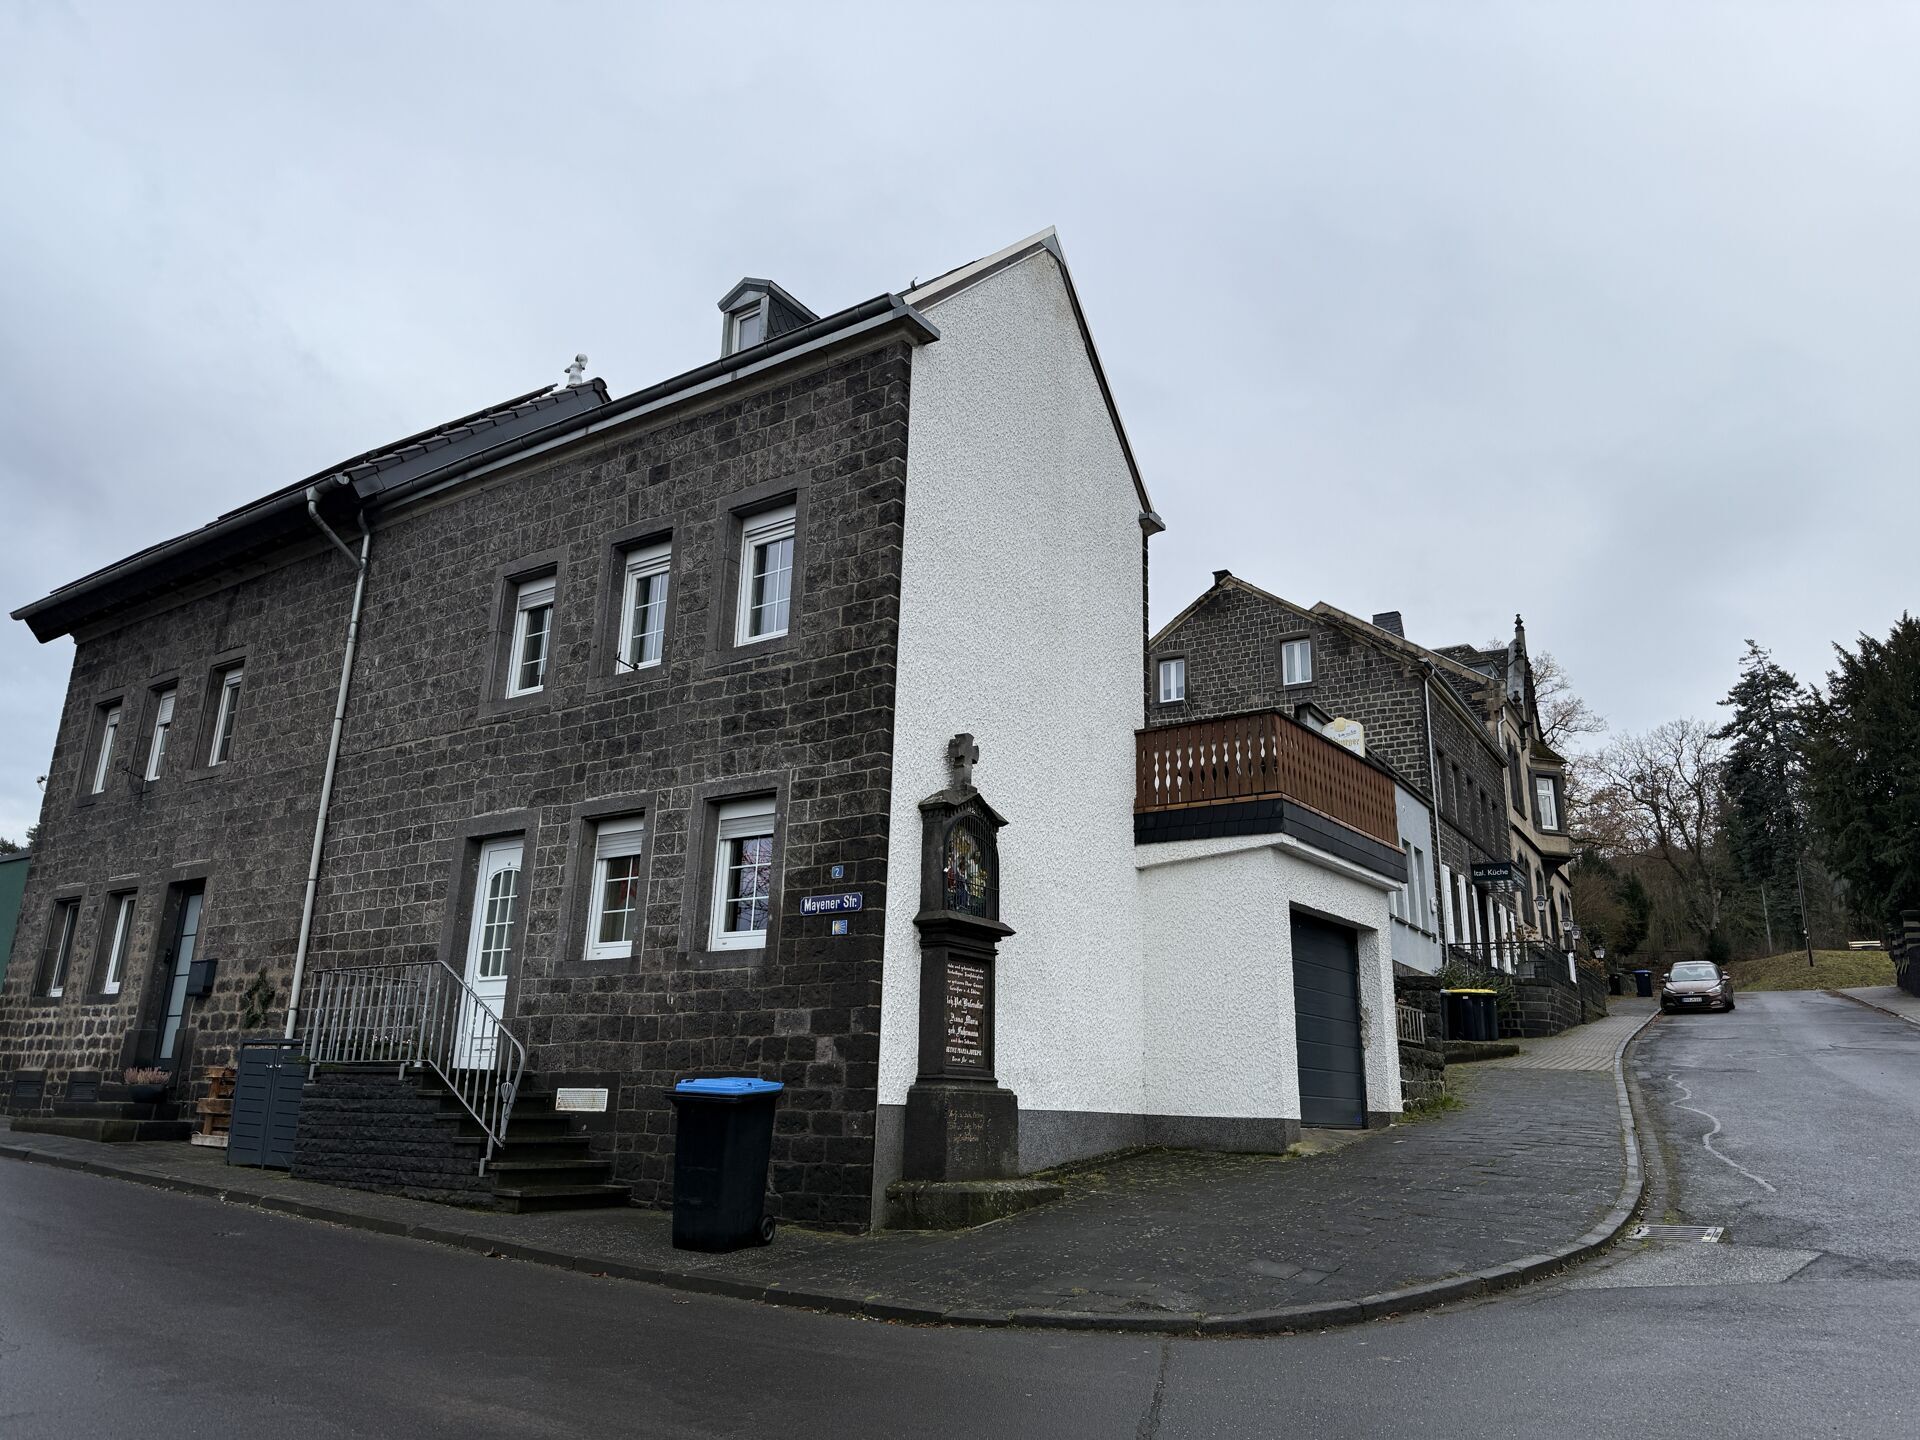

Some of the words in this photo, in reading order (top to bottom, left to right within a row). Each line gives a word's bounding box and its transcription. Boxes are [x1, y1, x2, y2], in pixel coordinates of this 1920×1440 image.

[1487, 868, 1509, 876] Küche
[804, 898, 840, 914] Mayener
[843, 894, 857, 908] Str.
